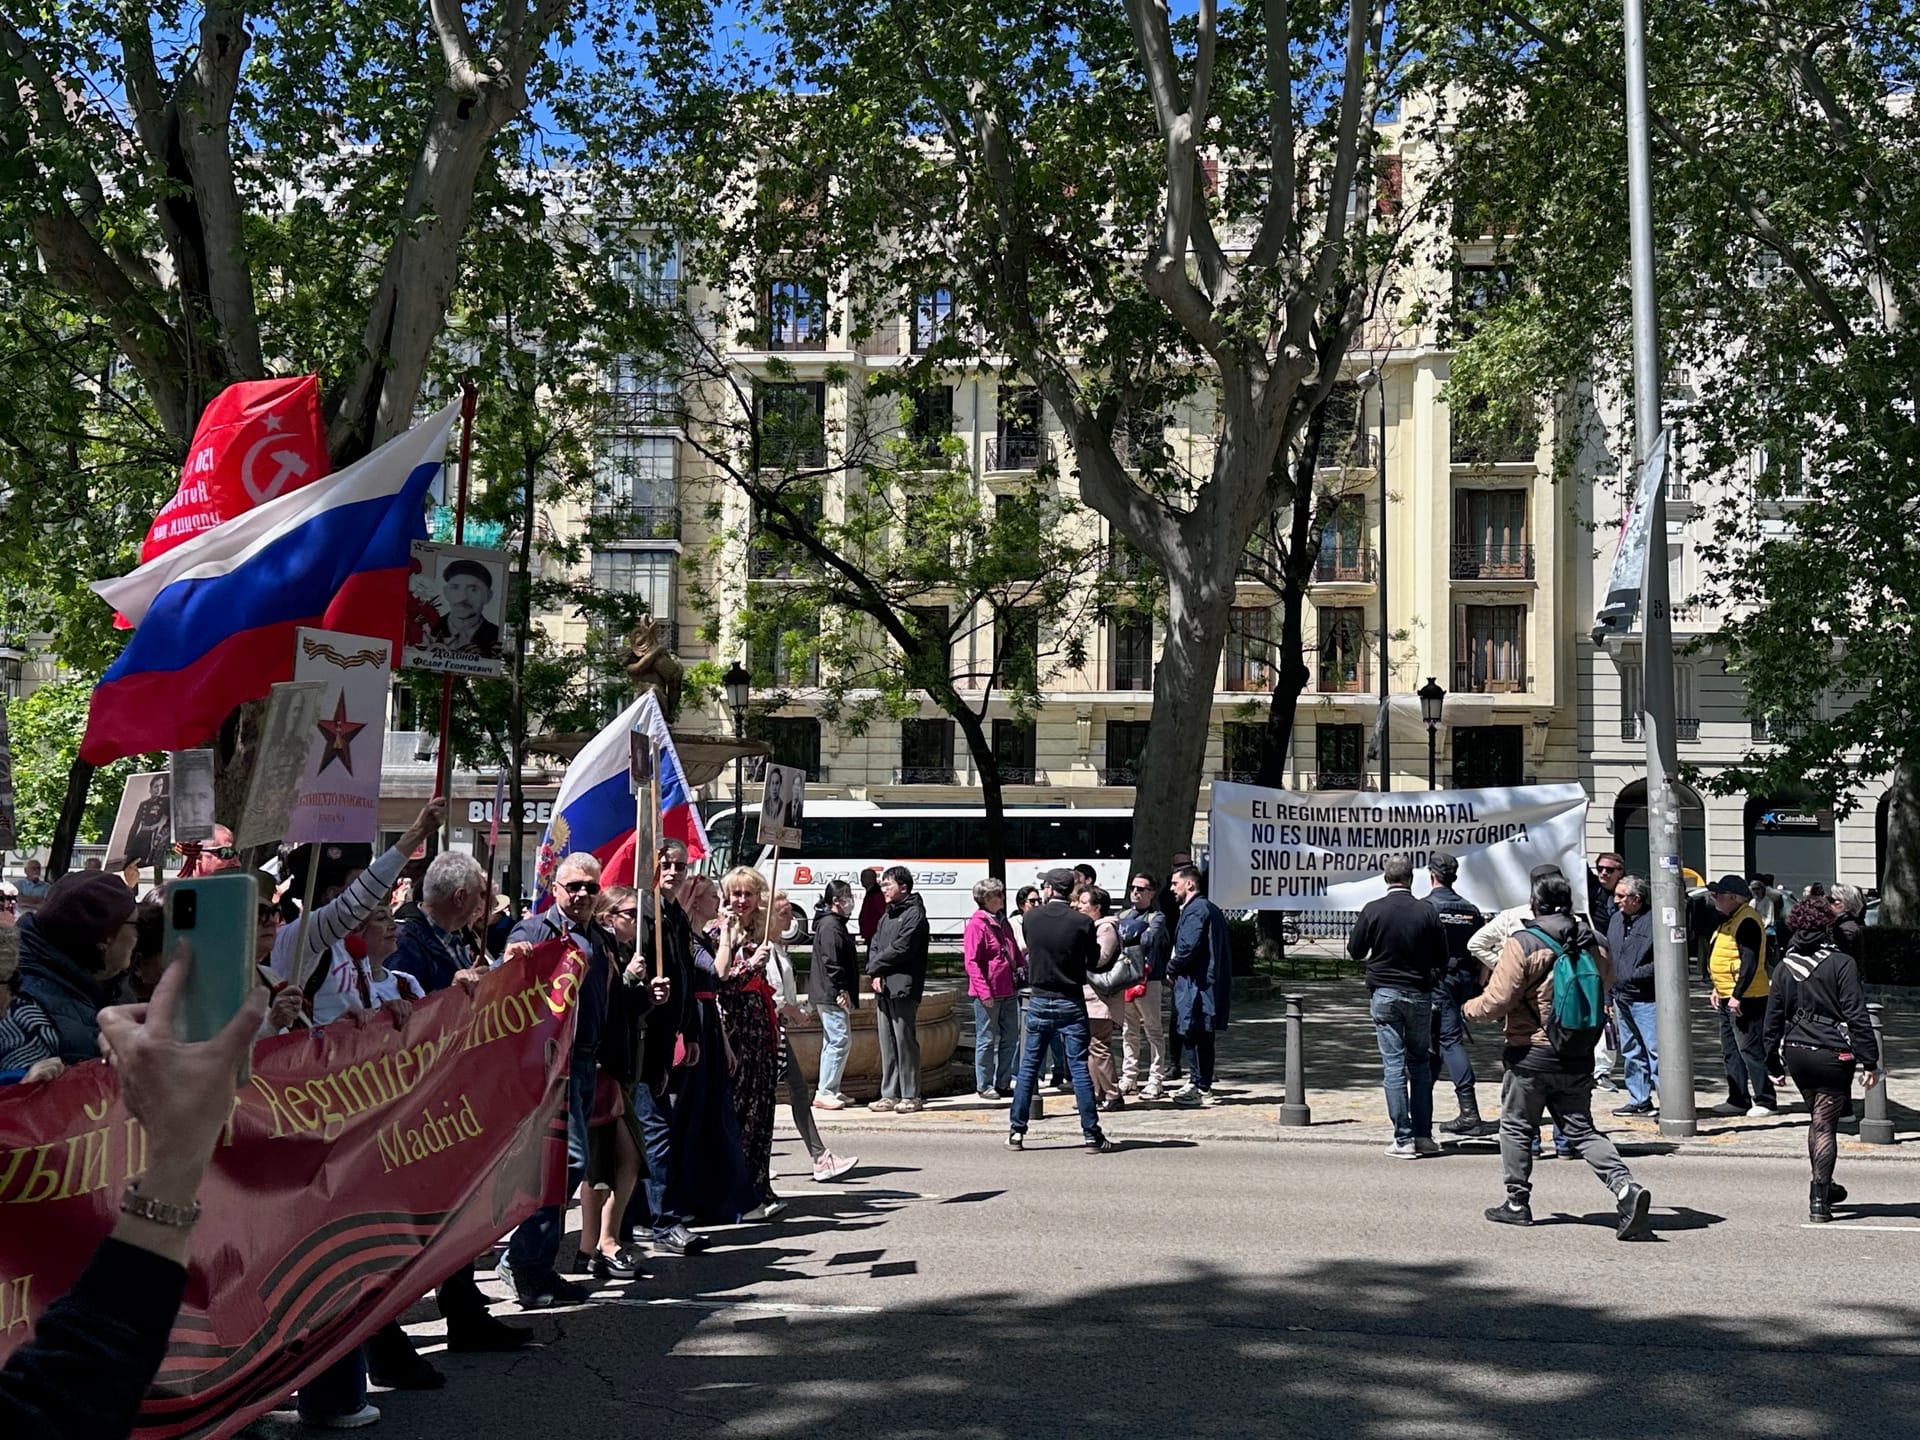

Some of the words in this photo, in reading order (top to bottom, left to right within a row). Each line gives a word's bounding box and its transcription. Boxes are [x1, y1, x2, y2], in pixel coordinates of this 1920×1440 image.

[1252, 800, 1272, 819] EL
[1277, 803, 1382, 823] REGIMIENTO
[1388, 802, 1479, 824] INMORTAL
[1251, 823, 1275, 844] NO
[1280, 824, 1301, 845] ES
[1306, 825, 1342, 847] UNA
[1347, 826, 1430, 849] MEMORIA
[1435, 823, 1529, 845] HISTÓRICA
[1250, 849, 1290, 871] SINO
[1296, 850, 1317, 871] LA
[1250, 876, 1272, 897] DE
[1277, 876, 1328, 897] PUTIN
[375, 1093, 483, 1175] Madrid
